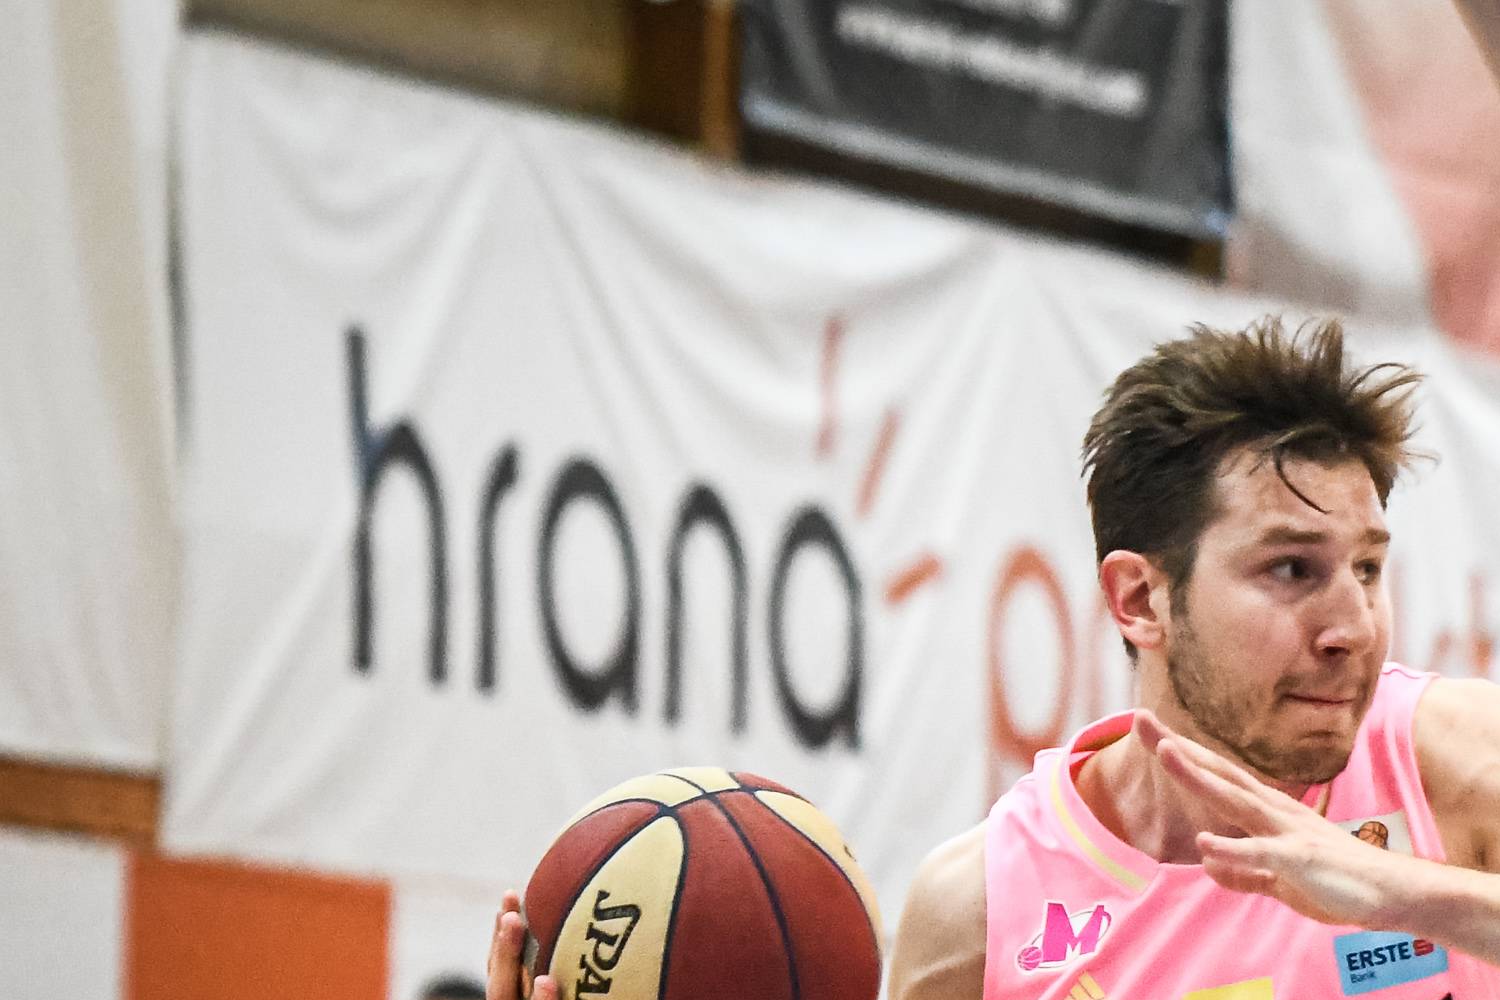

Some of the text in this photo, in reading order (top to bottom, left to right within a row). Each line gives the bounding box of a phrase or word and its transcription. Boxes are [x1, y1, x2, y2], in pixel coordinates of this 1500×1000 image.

[344, 322, 862, 750] hrana
[1346, 941, 1411, 971] ERSTE
[1350, 970, 1377, 984] Bank
